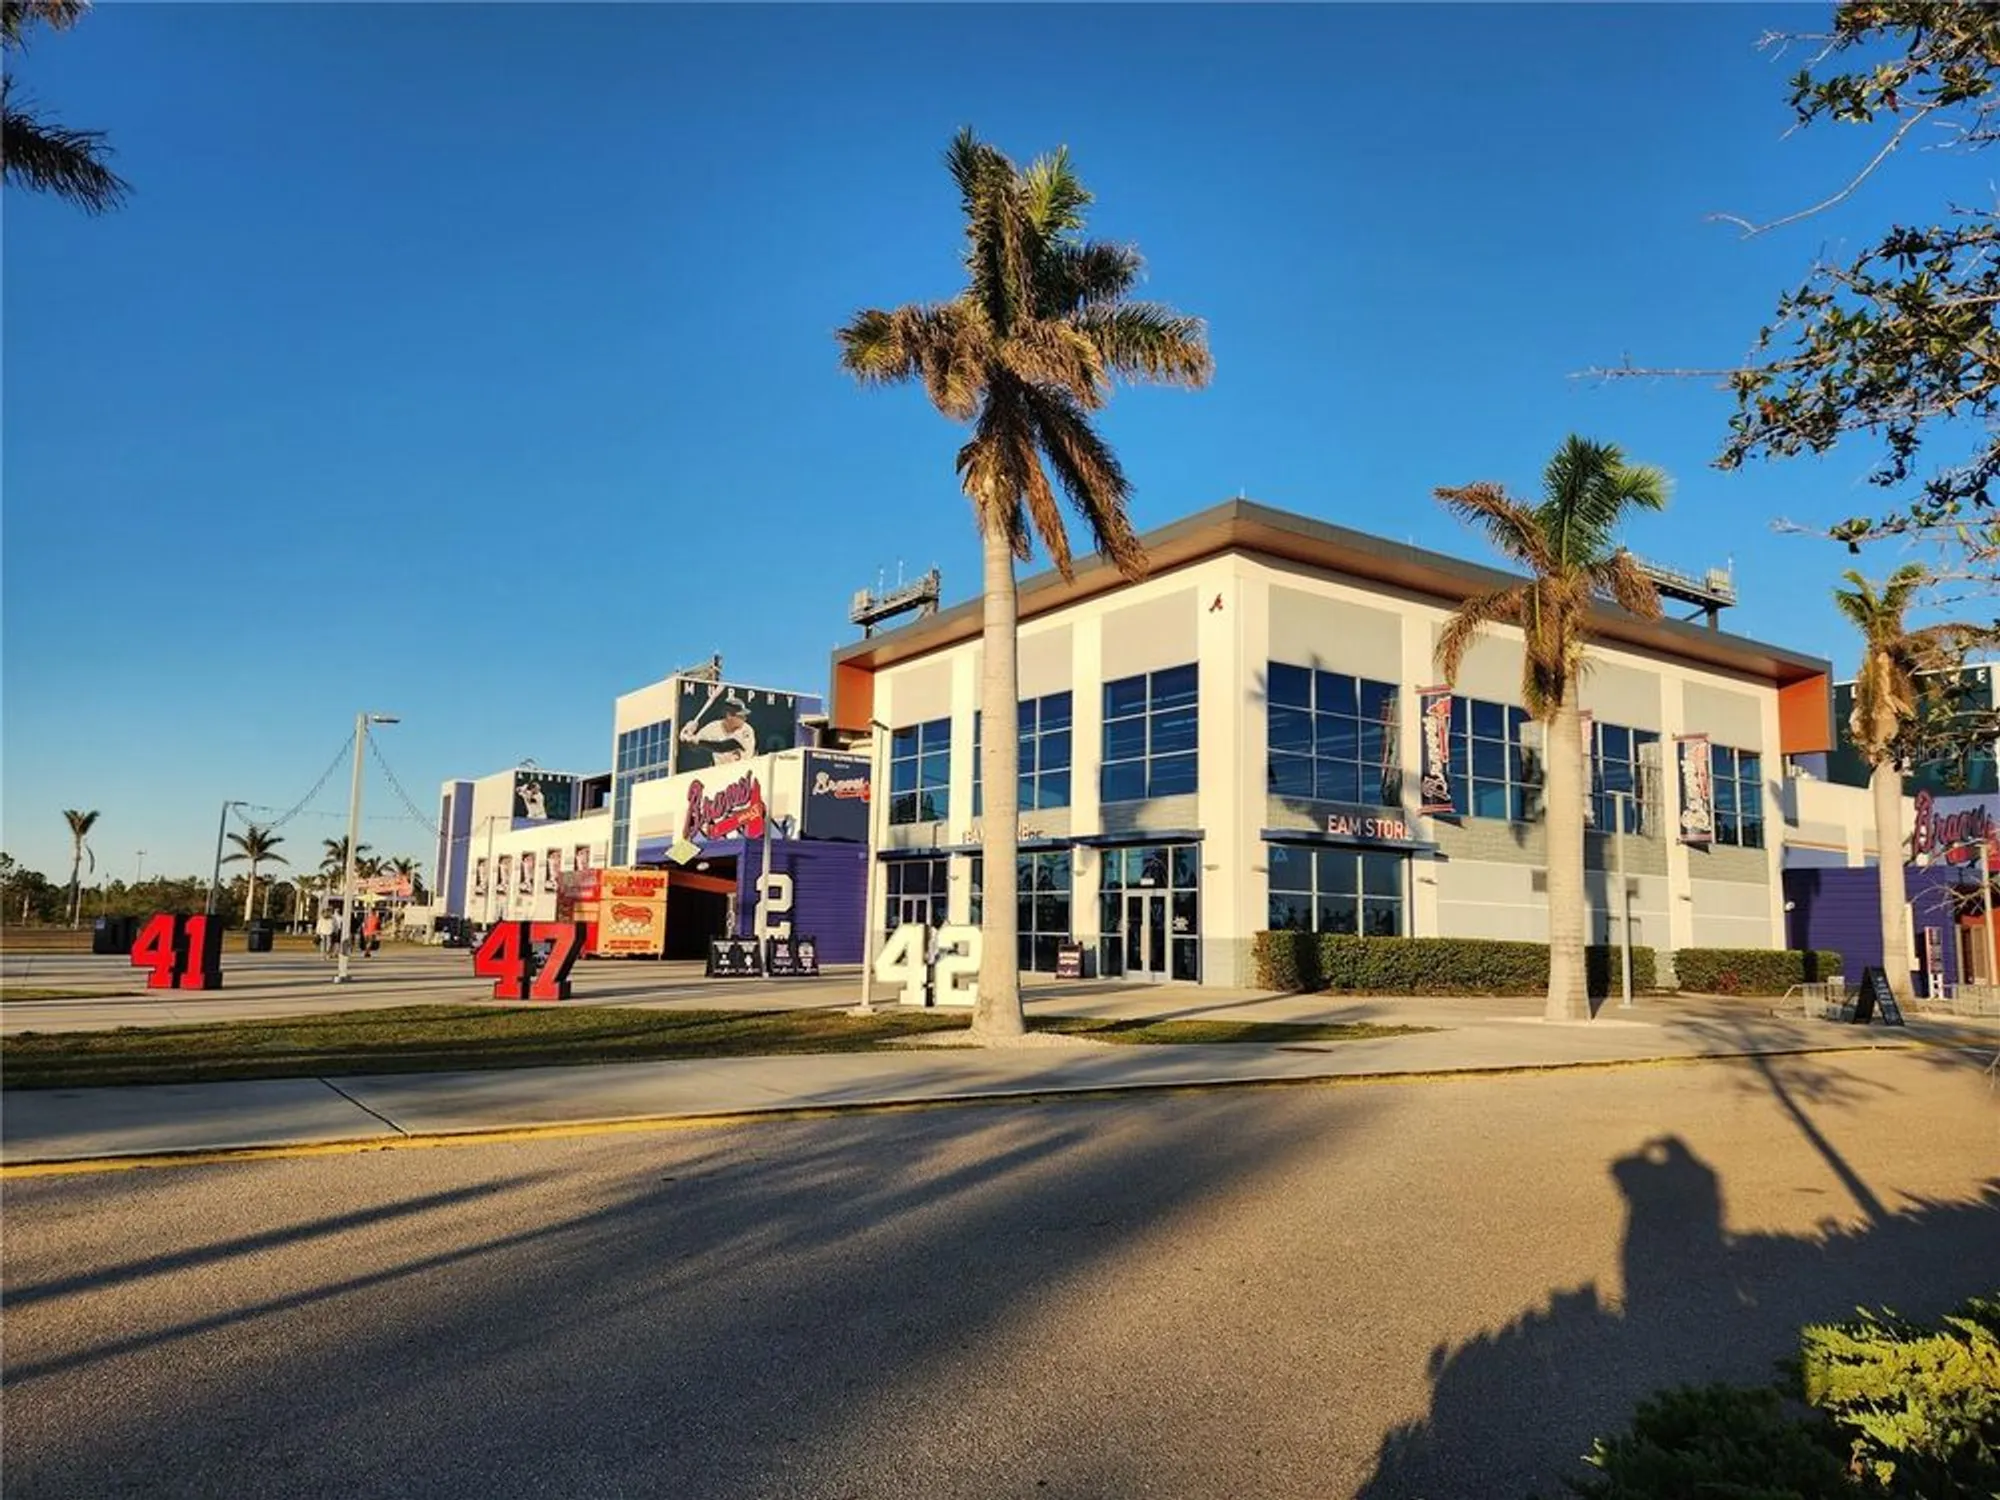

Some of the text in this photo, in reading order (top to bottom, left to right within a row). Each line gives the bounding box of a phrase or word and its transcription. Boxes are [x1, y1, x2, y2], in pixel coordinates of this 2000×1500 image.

[684, 682, 795, 708] MURPHY
[683, 770, 753, 840] Braves
[754, 873, 793, 940] 2
[130, 912, 208, 990] 41
[475, 921, 576, 999] 47
[875, 923, 984, 1005] 42
